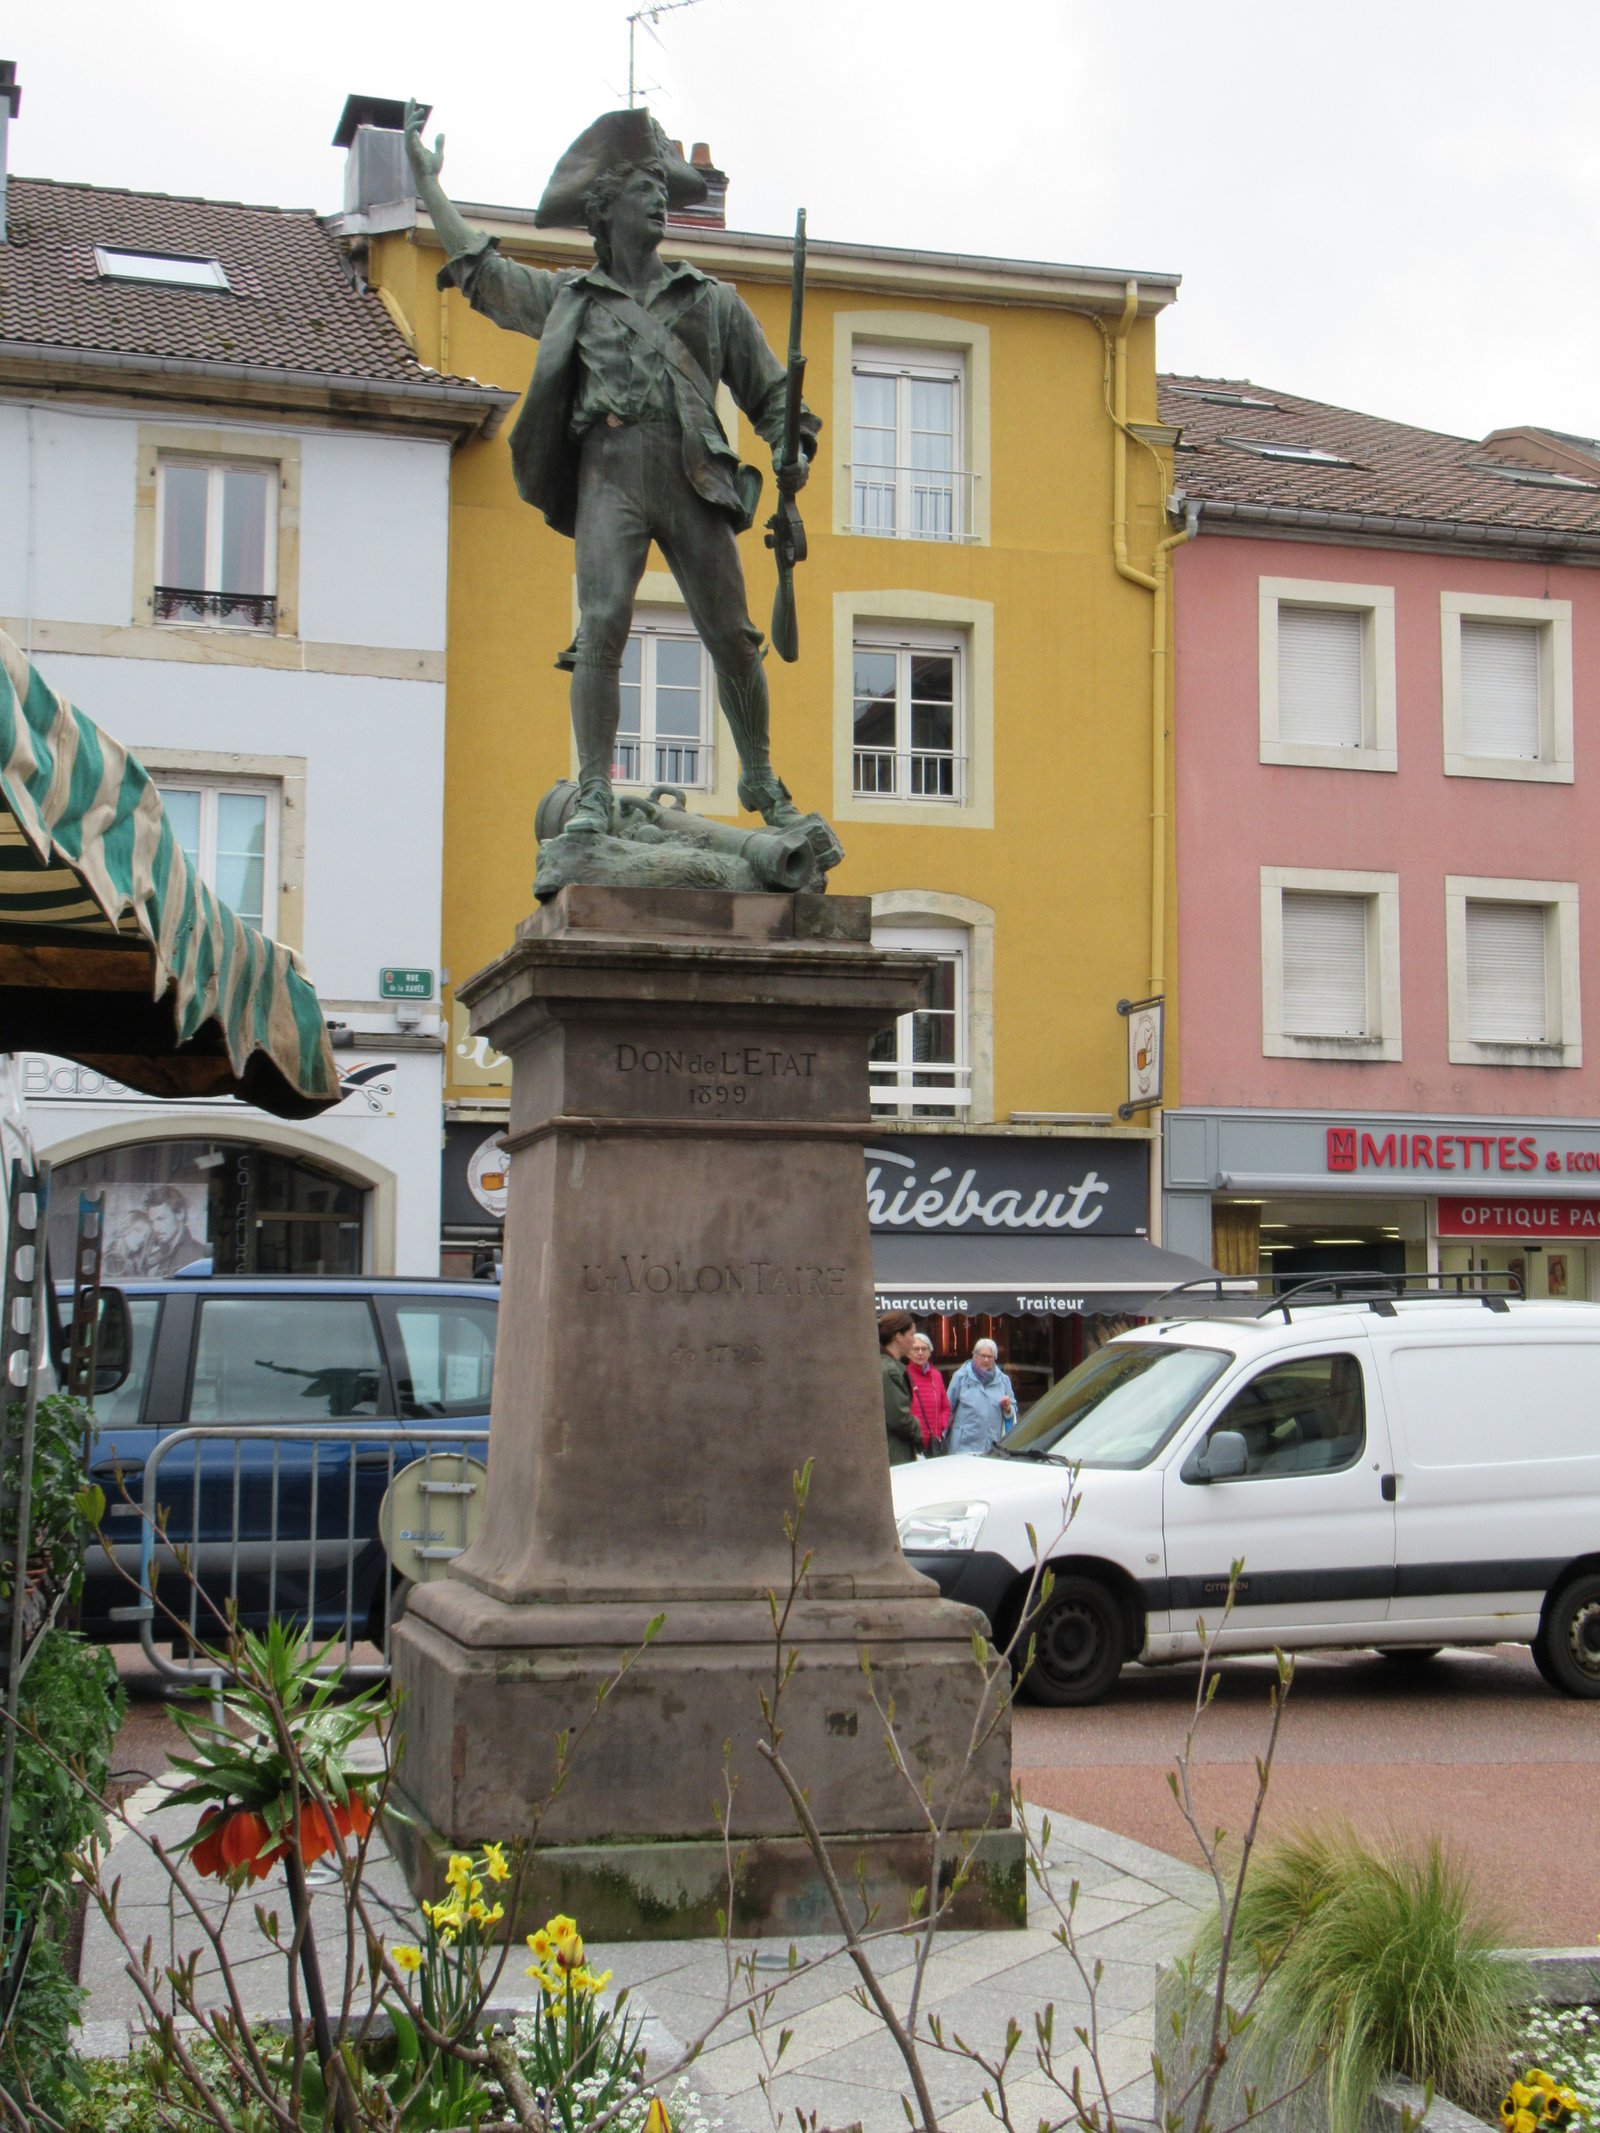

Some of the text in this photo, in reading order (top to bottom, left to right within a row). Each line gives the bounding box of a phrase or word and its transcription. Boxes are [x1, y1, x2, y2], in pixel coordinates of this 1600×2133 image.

[405, 974, 420, 982] RUE
[688, 1054, 716, 1075] de
[689, 1085, 747, 1105] 1899
[1361, 1132, 1539, 1171] MIRETTES
[1545, 1151, 1563, 1172] &
[864, 1147, 1110, 1229] hiébaut
[1460, 1206, 1600, 1228] OPTIQUE PA
[620, 1255, 847, 1298] VOLONTAIRE
[1016, 1296, 1084, 1311] Traiteur
